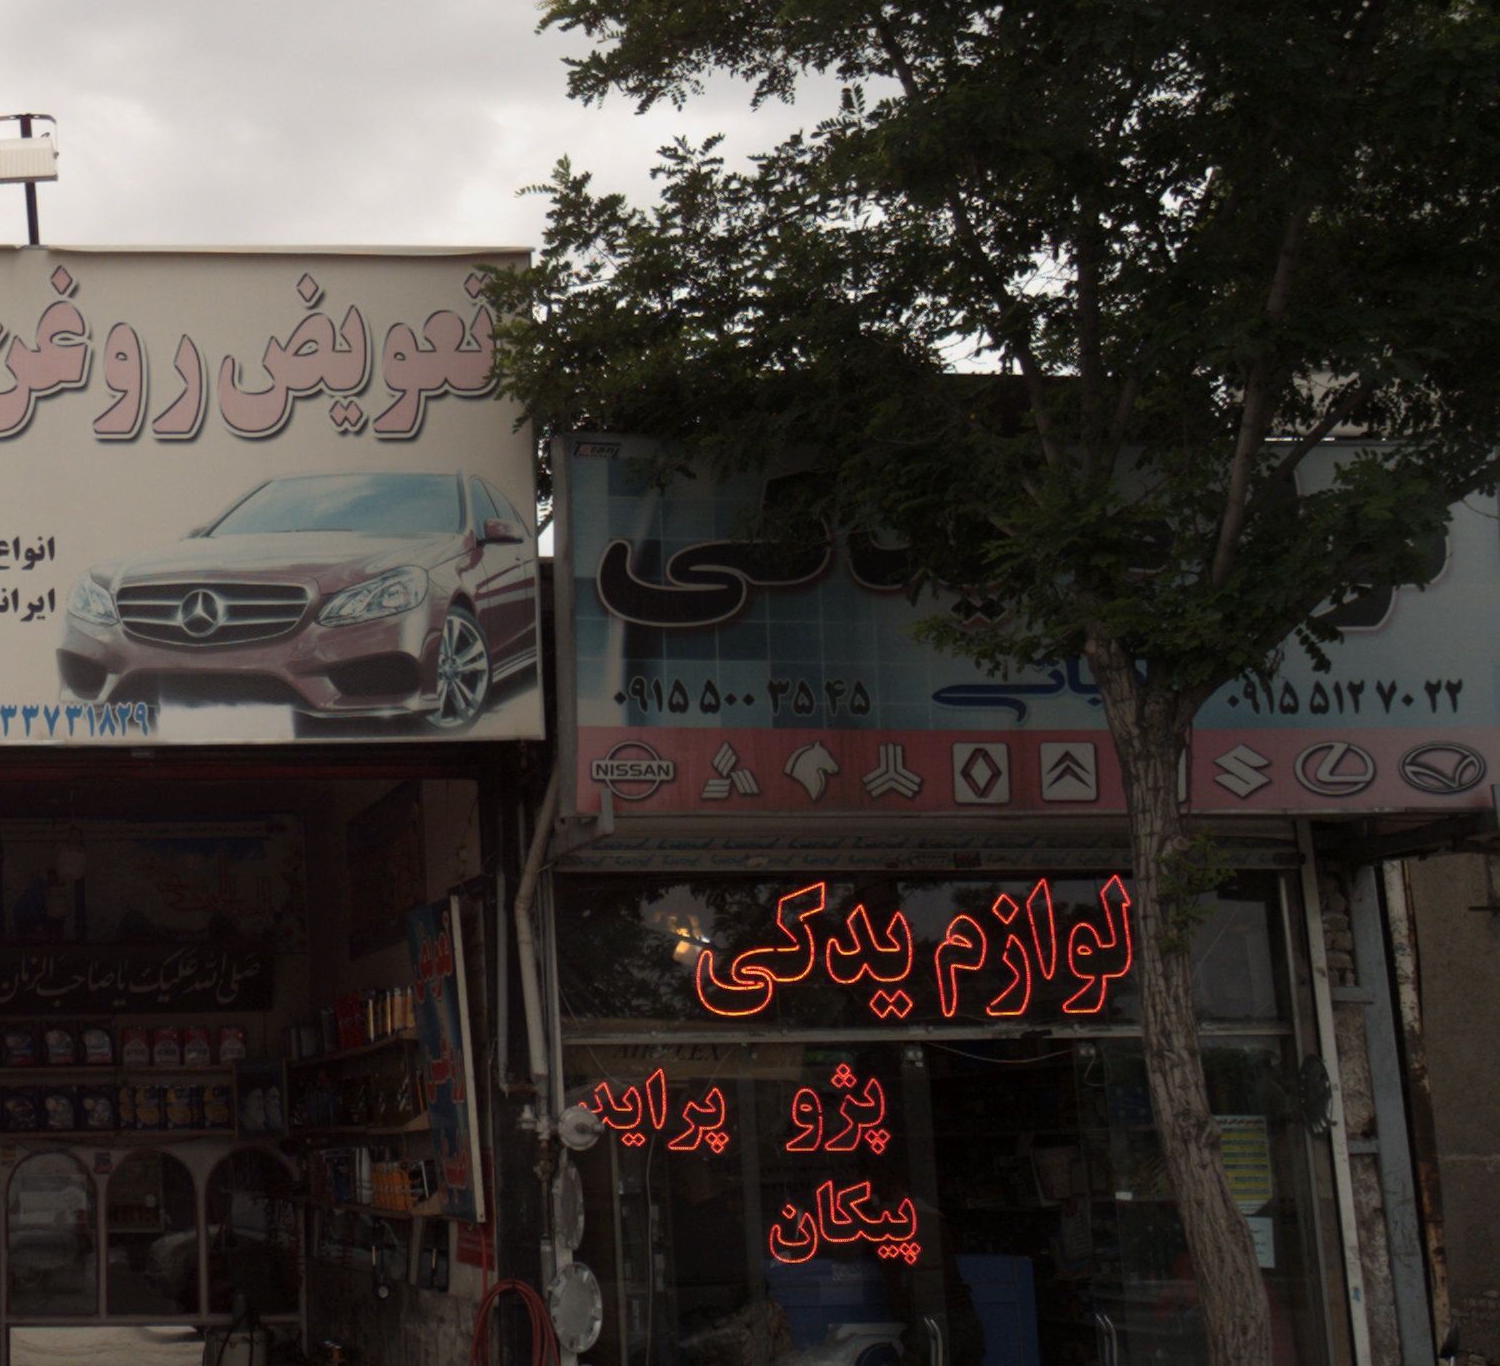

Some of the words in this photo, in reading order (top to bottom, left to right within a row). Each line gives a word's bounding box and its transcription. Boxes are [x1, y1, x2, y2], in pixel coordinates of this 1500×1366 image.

[213, 269, 500, 438] تعویض
[613, 676, 690, 715] ۰۹۱۵
[824, 678, 871, 716] ۴۵
[1227, 677, 1300, 716] ۰۹۱۵
[595, 763, 671, 778] NISSAN
[695, 881, 914, 1020] یدکی
[935, 875, 1133, 1018] لوازم
[577, 1066, 730, 1155] پراید
[785, 1062, 891, 1155] پژو
[768, 1178, 922, 1265] پیکان
